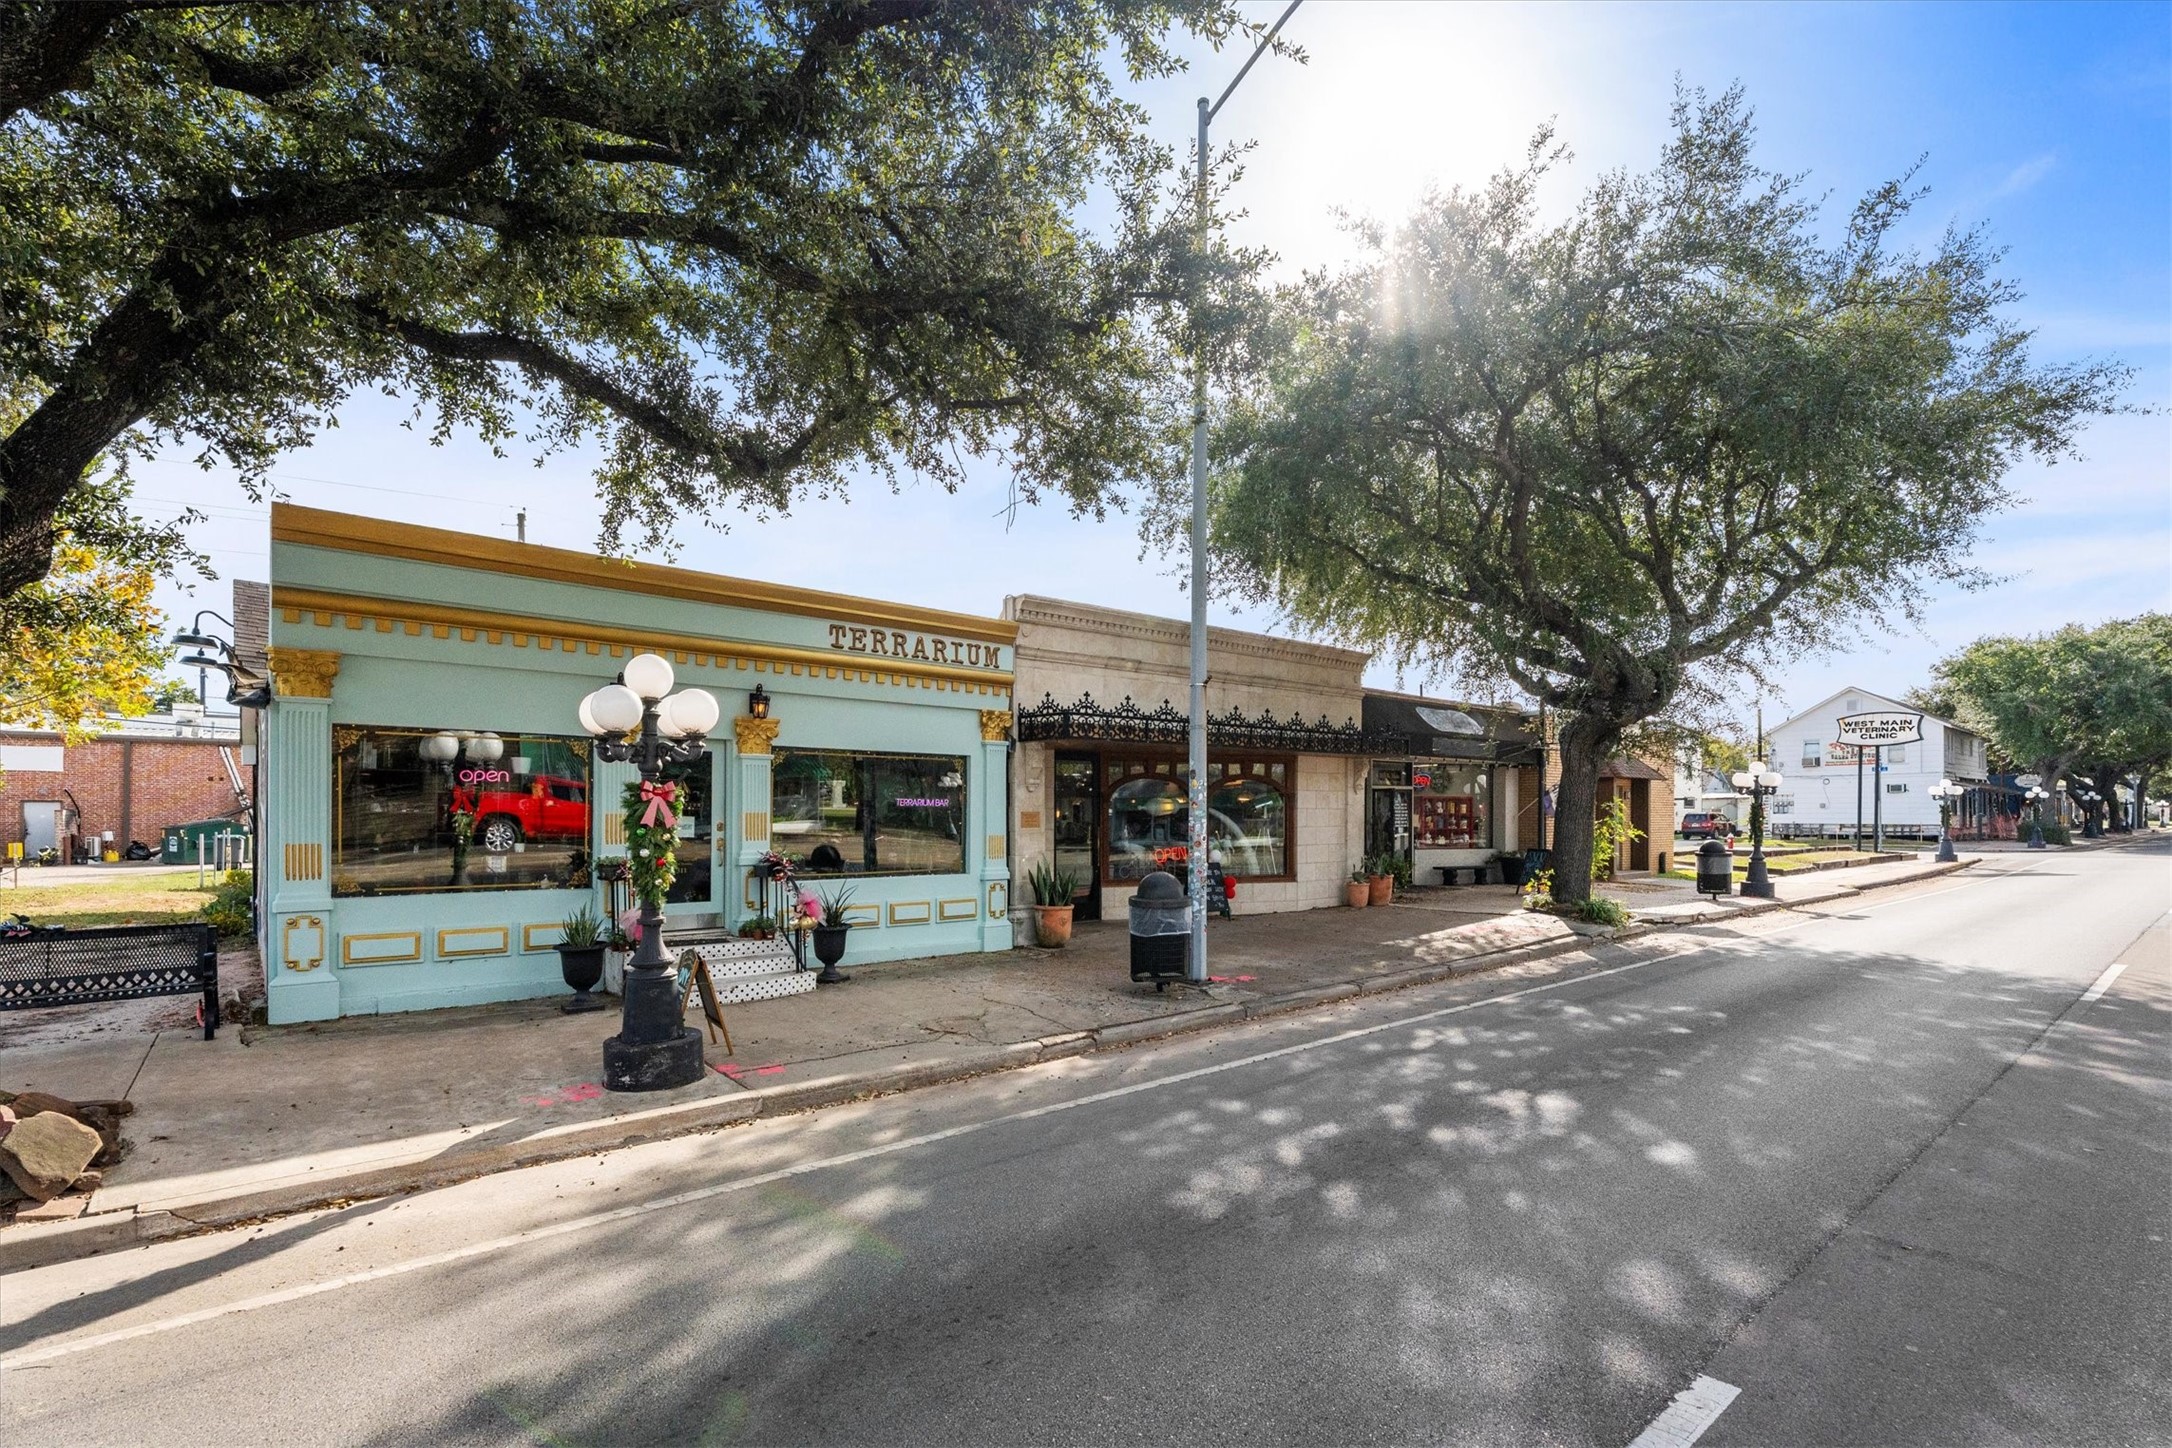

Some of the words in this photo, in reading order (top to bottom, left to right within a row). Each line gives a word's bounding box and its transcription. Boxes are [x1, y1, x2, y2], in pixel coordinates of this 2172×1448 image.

[829, 623, 1001, 668] TERRARIUM
[1843, 725, 1916, 734] VETERINARY
[1860, 732, 1898, 740] CLINIC
[459, 769, 510, 784] open
[896, 798, 935, 807] TERRARIUM
[935, 798, 950, 807] BAR
[1155, 846, 1187, 862] OPEN
